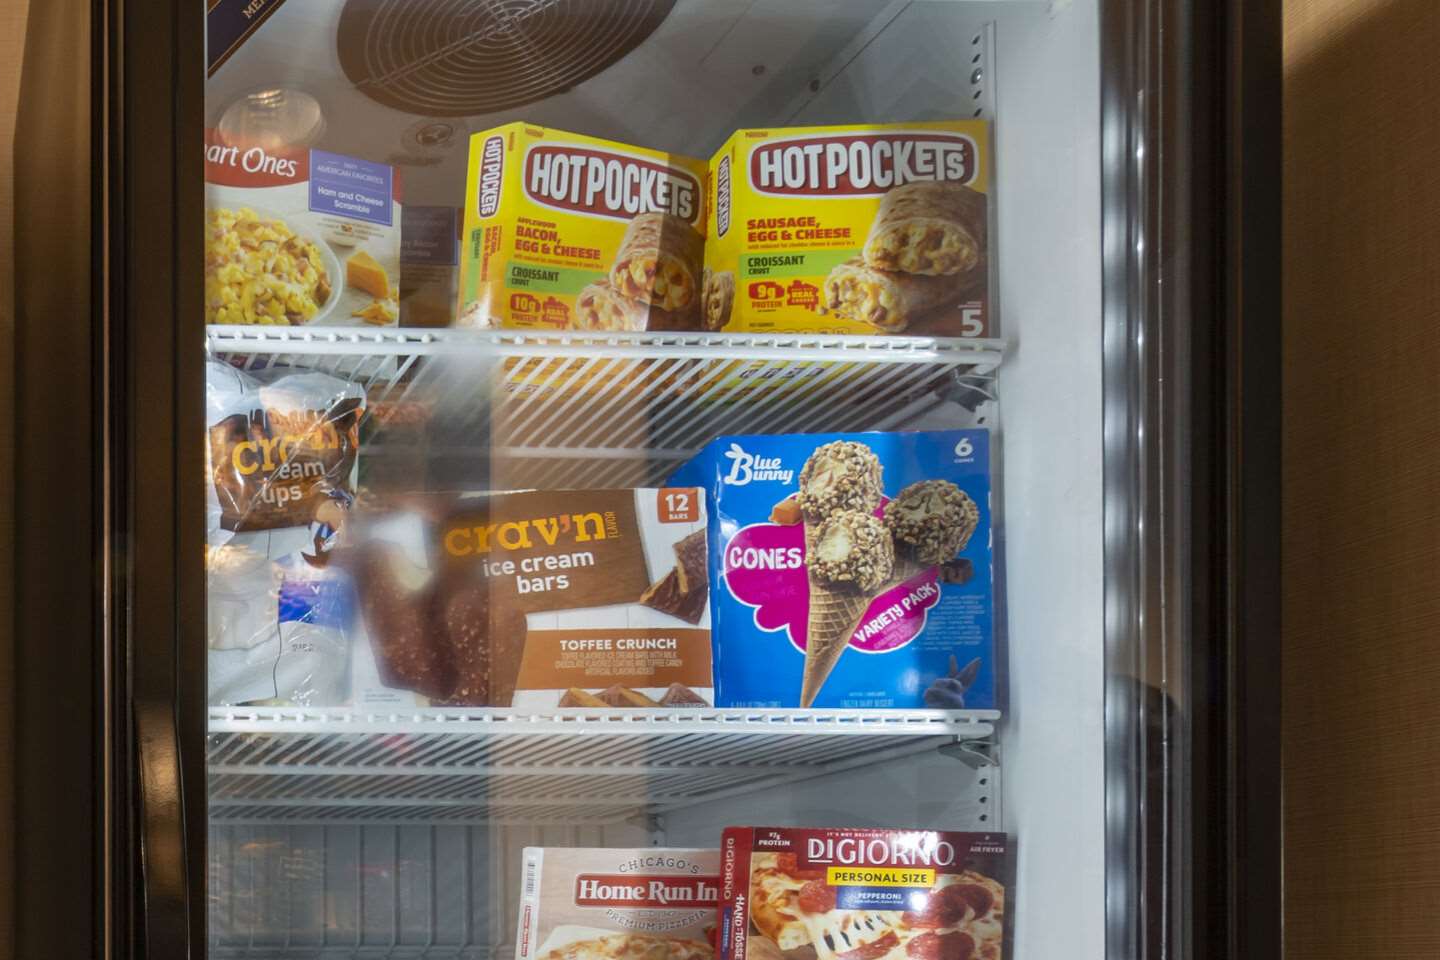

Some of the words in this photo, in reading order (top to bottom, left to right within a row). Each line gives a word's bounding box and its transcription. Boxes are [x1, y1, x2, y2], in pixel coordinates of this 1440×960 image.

[206, 143, 241, 167] art
[242, 147, 298, 178] Ones
[760, 142, 825, 190] HOT
[825, 140, 966, 189] POCKETS
[318, 186, 337, 197] Ham
[338, 191, 353, 200] and
[355, 194, 384, 207] Cheese
[747, 216, 821, 230] SAUSAGE,
[515, 224, 561, 243] BACON,
[747, 230, 778, 243] EGG
[781, 230, 793, 241] &
[795, 228, 851, 240] CHEESE
[514, 239, 539, 254] EGG
[541, 243, 551, 255] &
[553, 244, 601, 260] CHEESE
[748, 255, 805, 267] CROISSANT
[748, 267, 770, 275] CRUST
[511, 266, 560, 282] CROISSANT
[961, 308, 983, 338] 5
[955, 437, 974, 457] 6
[665, 493, 689, 513] 12
[668, 512, 689, 521] BARS
[444, 510, 606, 556] crav'n
[483, 558, 515, 577] ice
[520, 551, 595, 573] cream
[729, 547, 802, 570] CONES
[516, 573, 570, 595] bars
[853, 604, 905, 643] VARIETY
[901, 582, 937, 611] PACK
[559, 639, 613, 651] TOFFEE
[616, 638, 677, 650] CRUNCH
[618, 856, 701, 875] CHICAGO'S
[834, 871, 898, 883] PERSONAL
[902, 873, 928, 883] SIZE
[579, 879, 646, 901] Home
[648, 880, 695, 904] Run
[858, 892, 902, 900] PEPPERONI
[606, 908, 656, 930] PREMIUM
[657, 909, 708, 931] PIZZERIA
